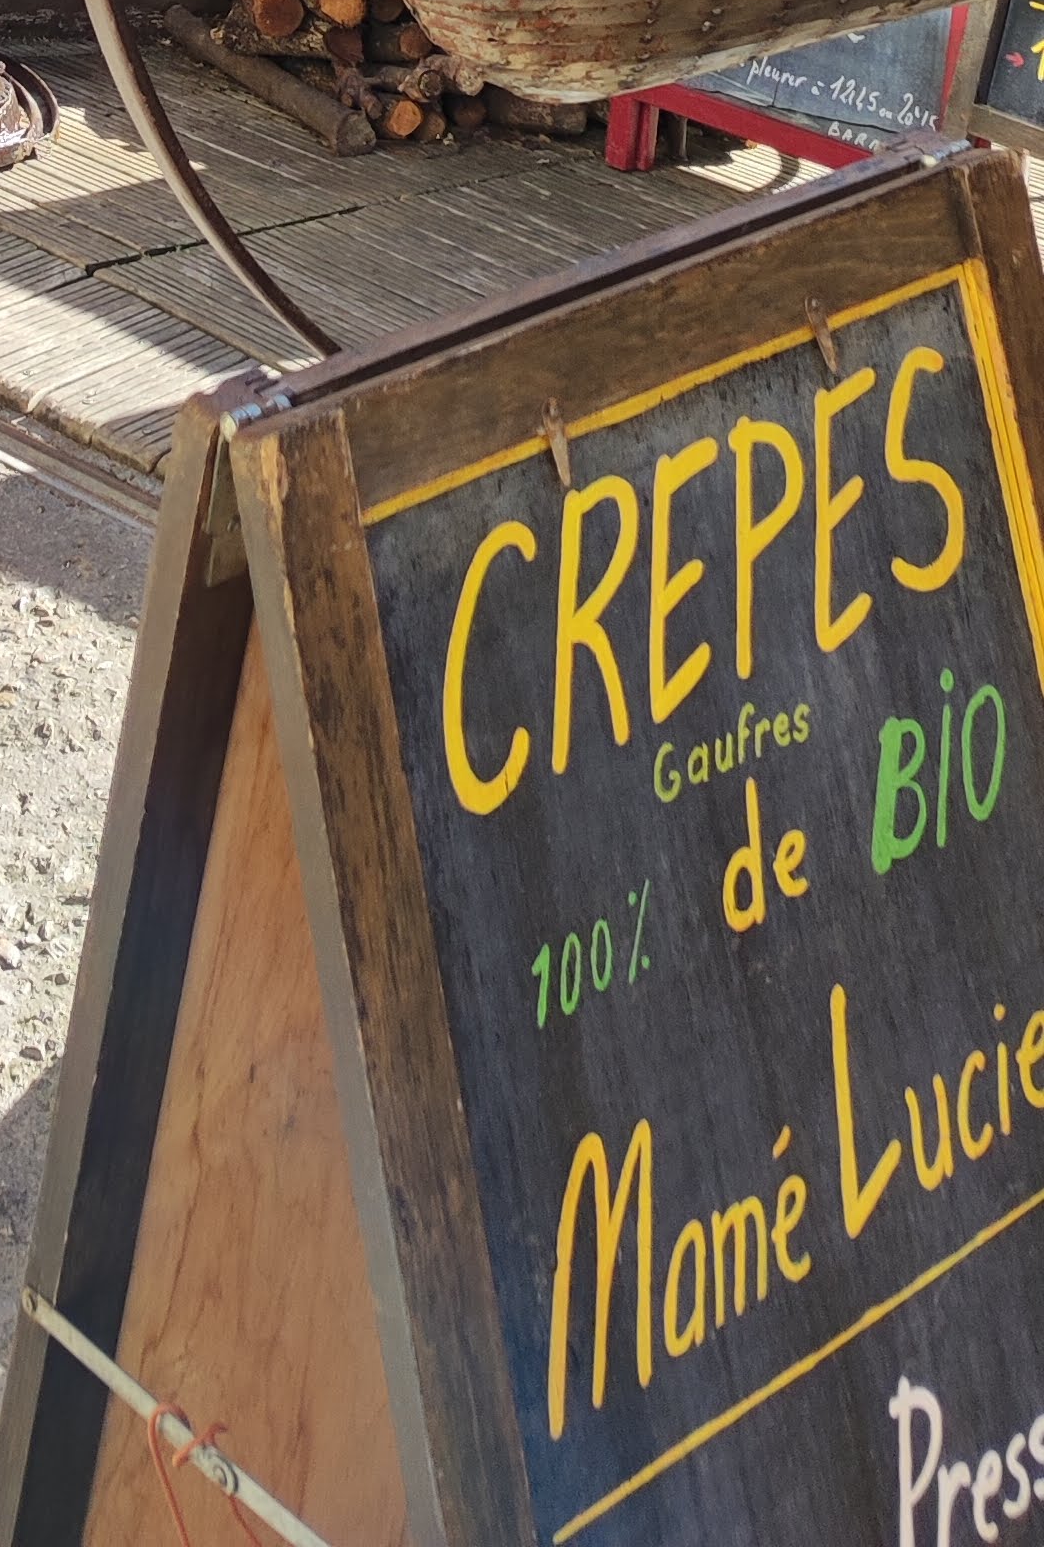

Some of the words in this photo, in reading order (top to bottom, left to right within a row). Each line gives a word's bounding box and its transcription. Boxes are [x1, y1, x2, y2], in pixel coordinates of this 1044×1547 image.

[746, 56, 808, 88] pleurer
[443, 345, 965, 816] CREPES
[653, 702, 811, 803] Gaufres
[722, 775, 809, 933] de
[547, 1117, 812, 1441] Mamé
[829, 982, 1044, 1240] Lucie
